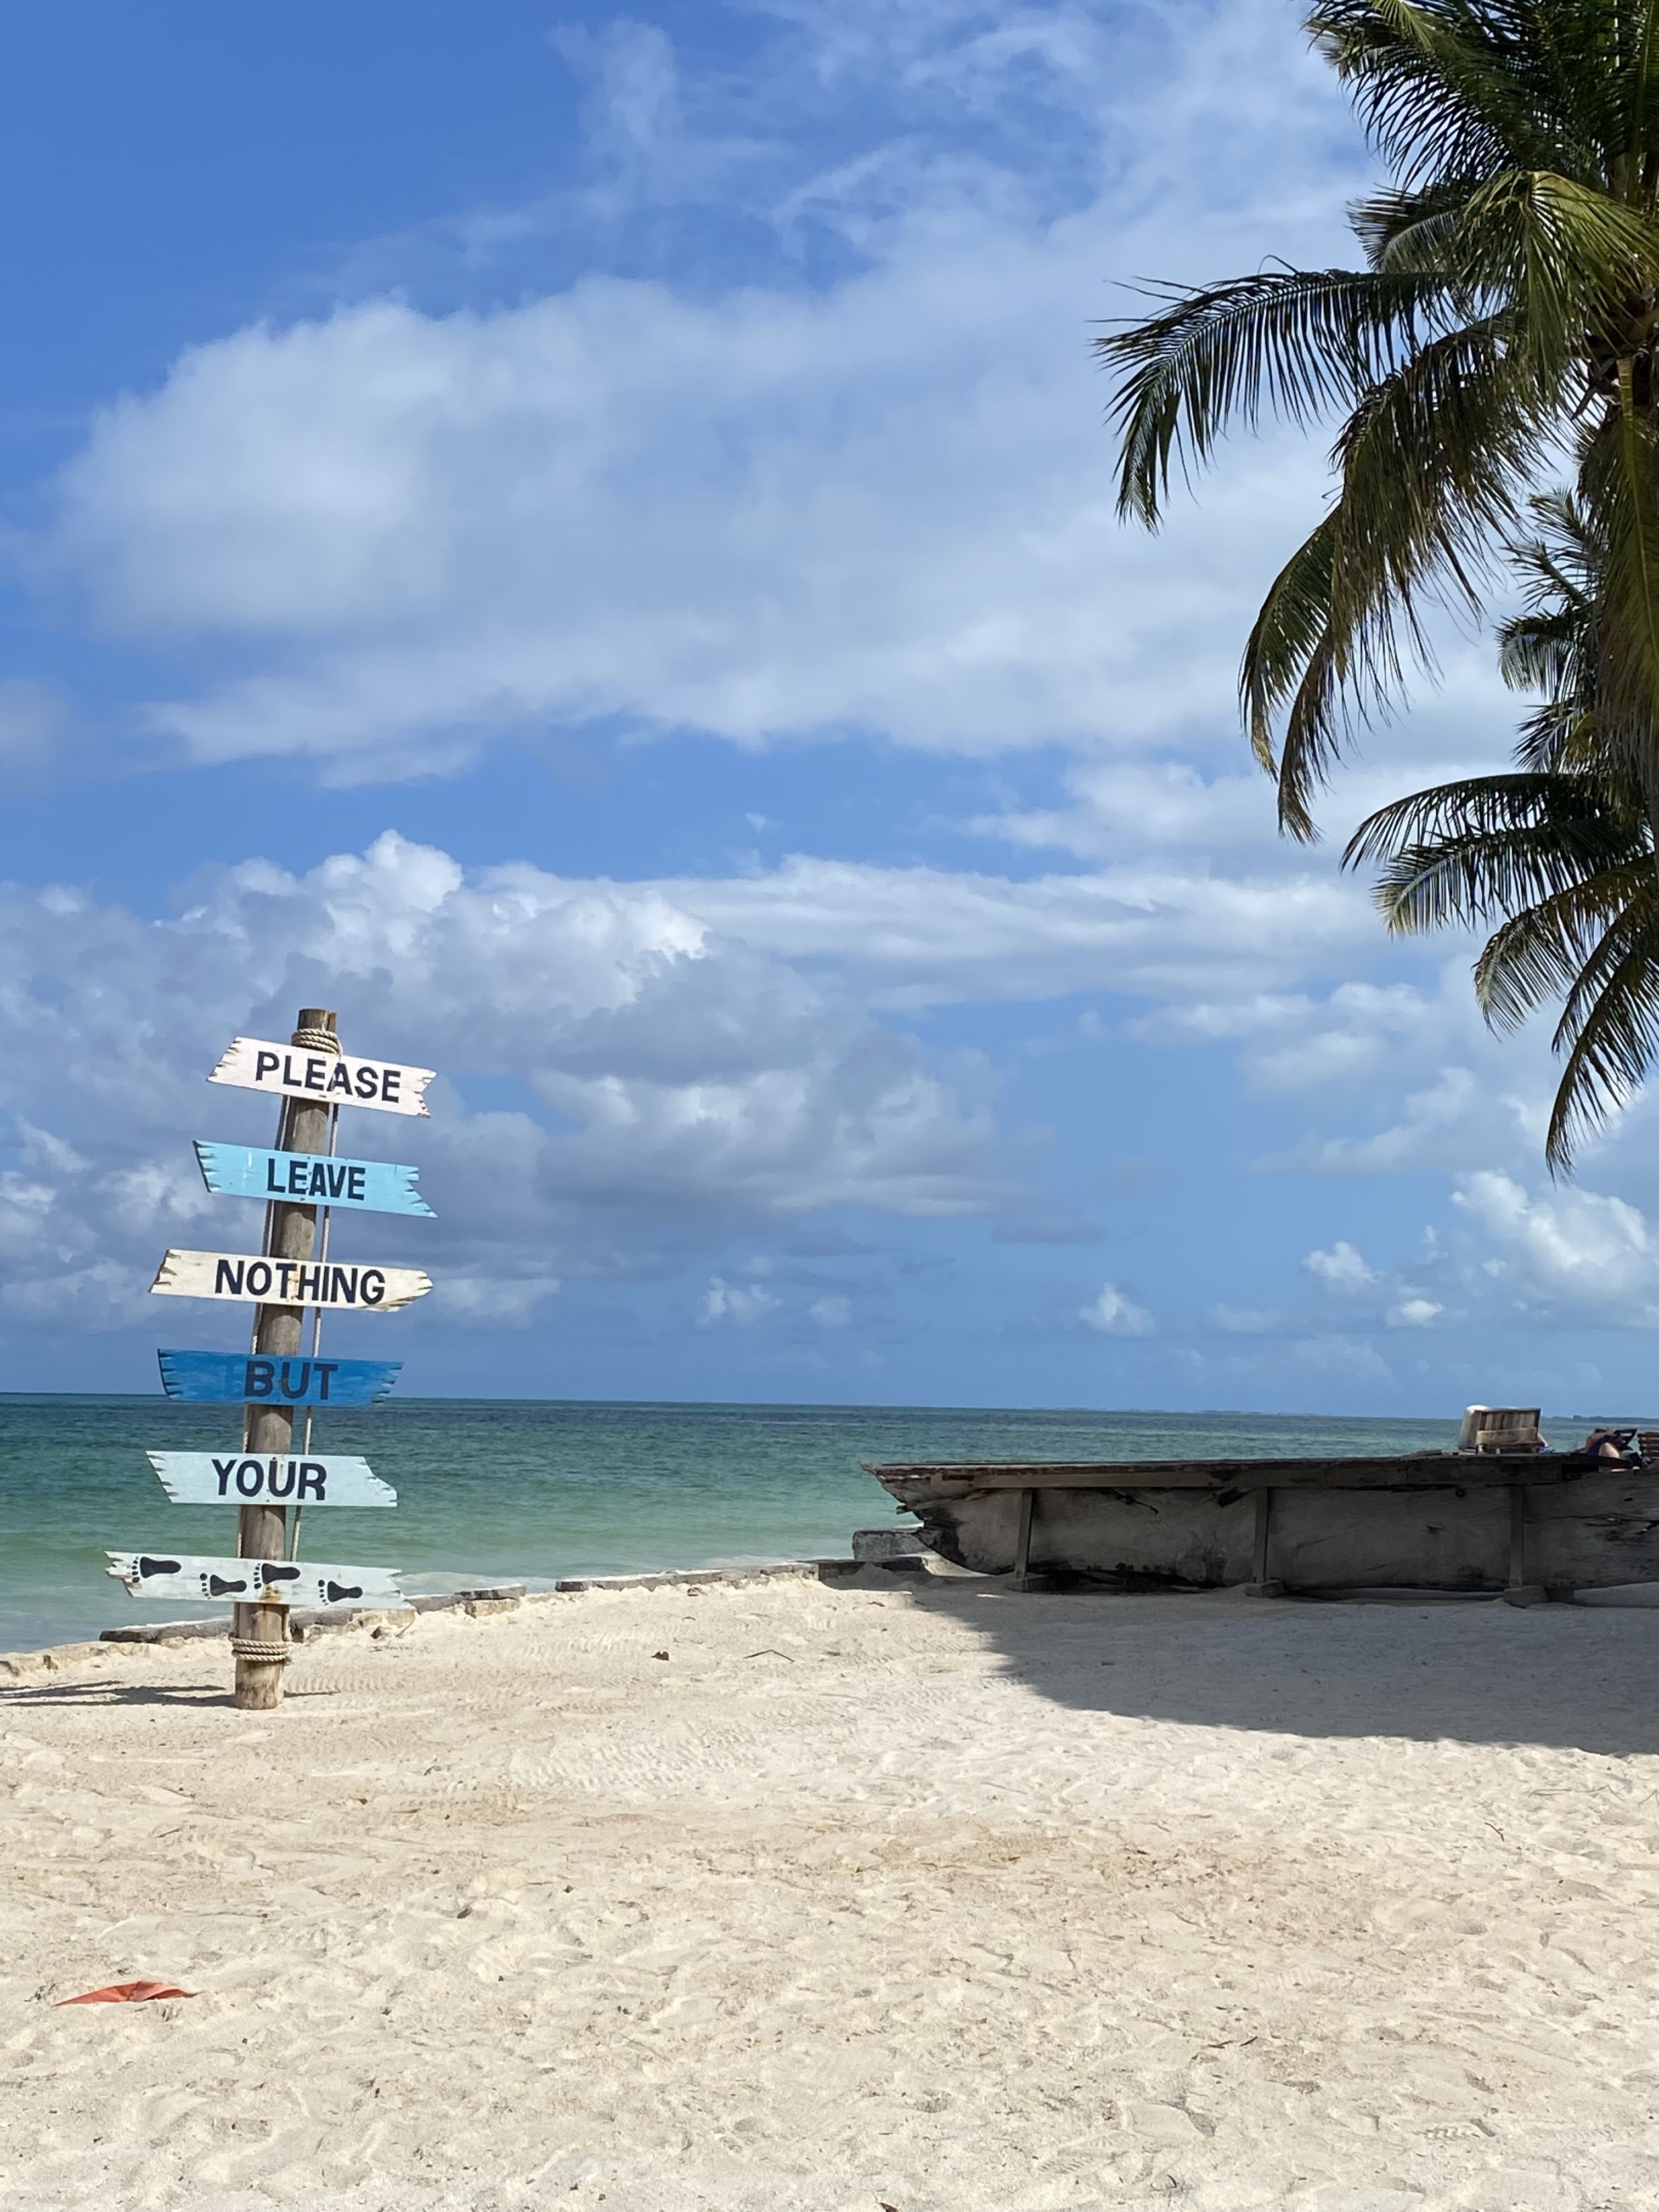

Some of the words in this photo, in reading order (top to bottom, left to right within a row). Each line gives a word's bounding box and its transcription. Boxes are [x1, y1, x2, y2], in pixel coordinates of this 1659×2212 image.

[256, 1051, 401, 1103] PLEASE
[267, 1158, 366, 1201] LEAVE
[215, 1259, 385, 1305] NOTHING
[244, 1360, 339, 1400] BUT
[211, 1458, 328, 1501] YOUR
